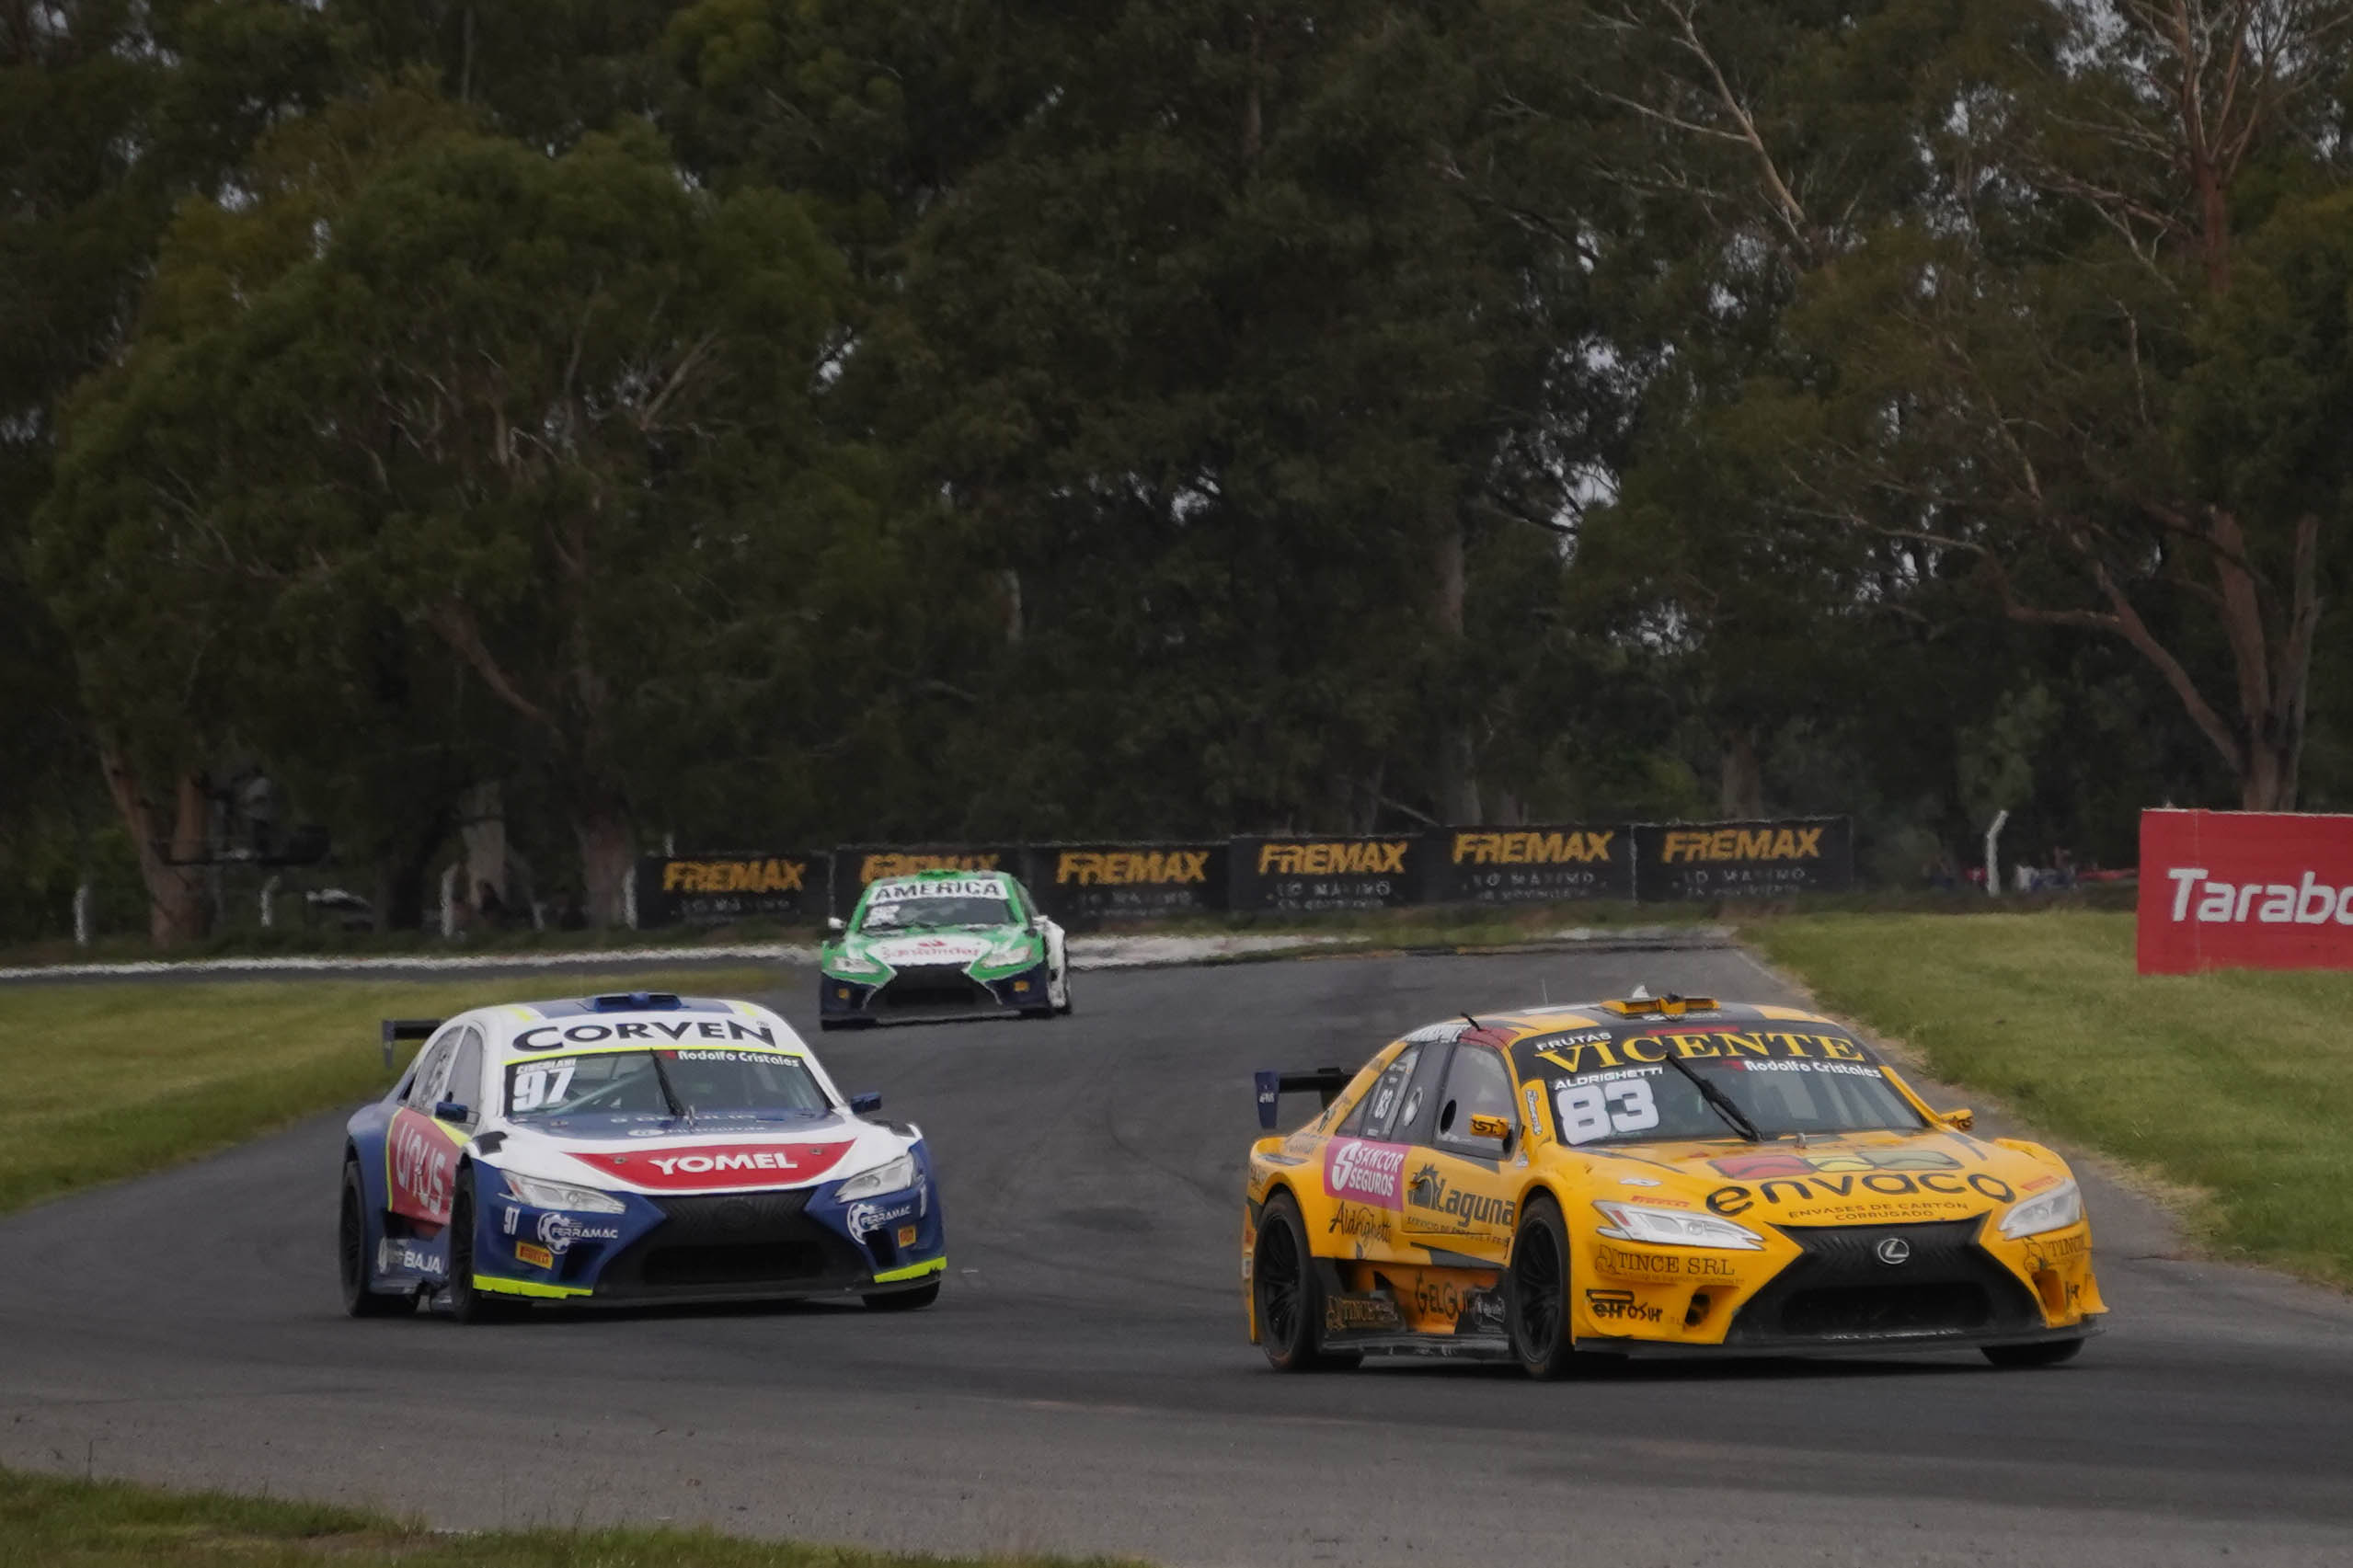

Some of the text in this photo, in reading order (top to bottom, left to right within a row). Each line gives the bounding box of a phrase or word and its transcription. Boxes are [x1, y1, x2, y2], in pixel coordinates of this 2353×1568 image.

[1258, 841, 1407, 875] FREMAX
[1452, 830, 1613, 864] FREMAX
[1662, 827, 1822, 864] FREMAX
[662, 858, 806, 891] FREMAX
[1056, 851, 1209, 886] FREMAX
[511, 1019, 776, 1053] CORVEN
[1535, 1032, 1612, 1051] FRUTAS
[679, 1050, 799, 1068] Rodolfo Cristales
[1534, 1032, 1865, 1072] VICENTE
[1555, 1067, 1663, 1090] ALDRIGHETTI
[1744, 1059, 1882, 1079] Rodolfo Cristales
[513, 1067, 574, 1111] 97
[1556, 1077, 1659, 1146] 83
[649, 1151, 798, 1175] YOMEL
[1355, 1147, 1404, 1173] SANCOR
[1349, 1167, 1395, 1197] SEGUROS
[1705, 1173, 2016, 1217] envaco
[860, 1206, 911, 1226] FERRAMAC
[1435, 1178, 1515, 1228] Laguna
[1789, 1205, 1865, 1219] ENVASES
[1870, 1203, 1892, 1211] DE
[504, 1206, 520, 1235] 97
[551, 1226, 618, 1240] FERRAMAC
[404, 1250, 442, 1274] BAJA
[1686, 1257, 1735, 1276] SRL
